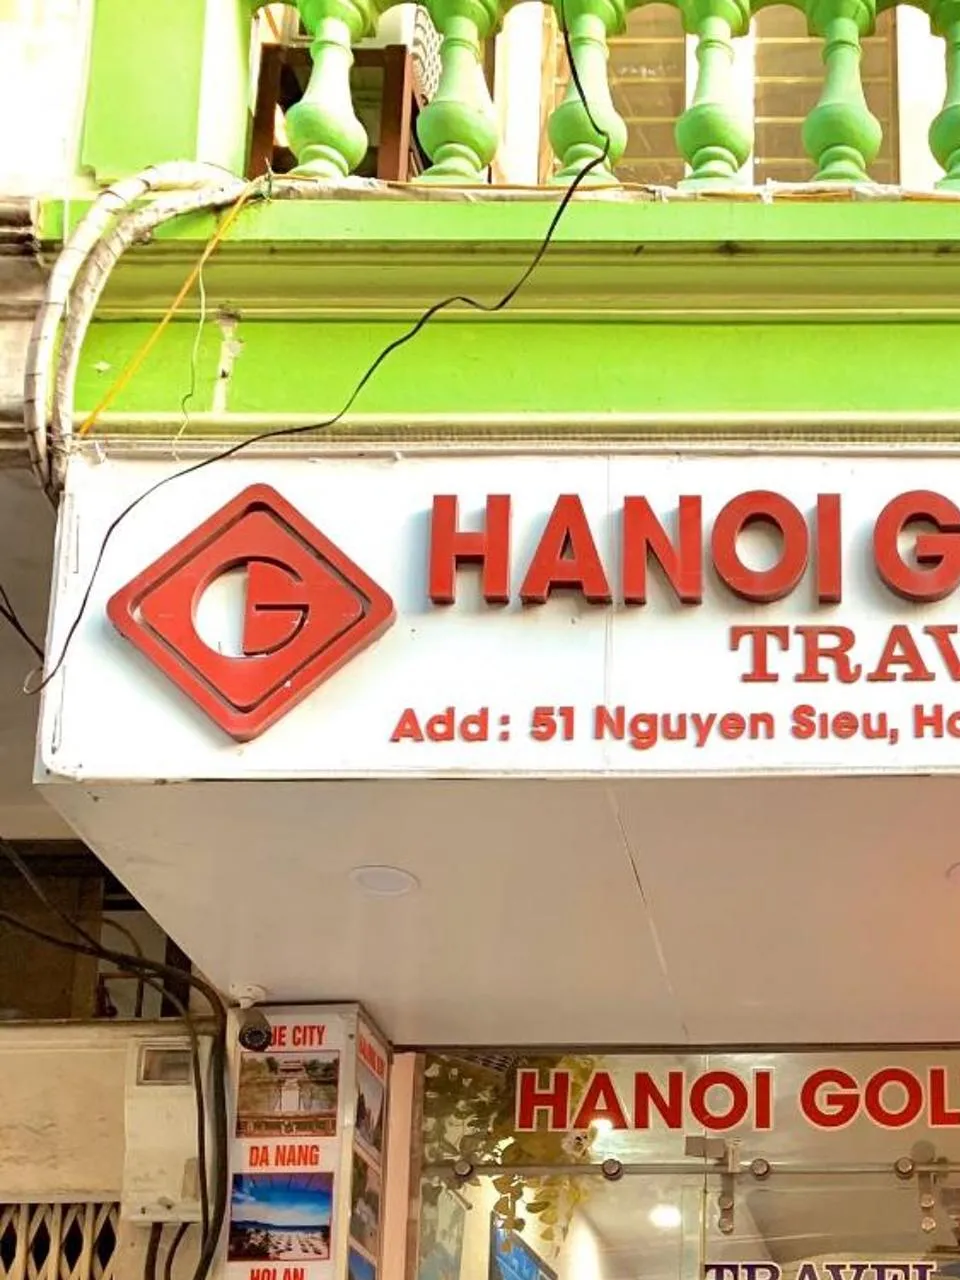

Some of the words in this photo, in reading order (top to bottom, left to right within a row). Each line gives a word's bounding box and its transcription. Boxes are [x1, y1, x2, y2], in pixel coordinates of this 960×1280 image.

[427, 491, 843, 606] HANOI
[529, 706, 576, 741] 51
[594, 704, 775, 750] Nguyen
[292, 1024, 327, 1046] CITY
[514, 1067, 774, 1132] HANOI
[249, 1146, 270, 1168] DA
[275, 1144, 321, 1167] NANG
